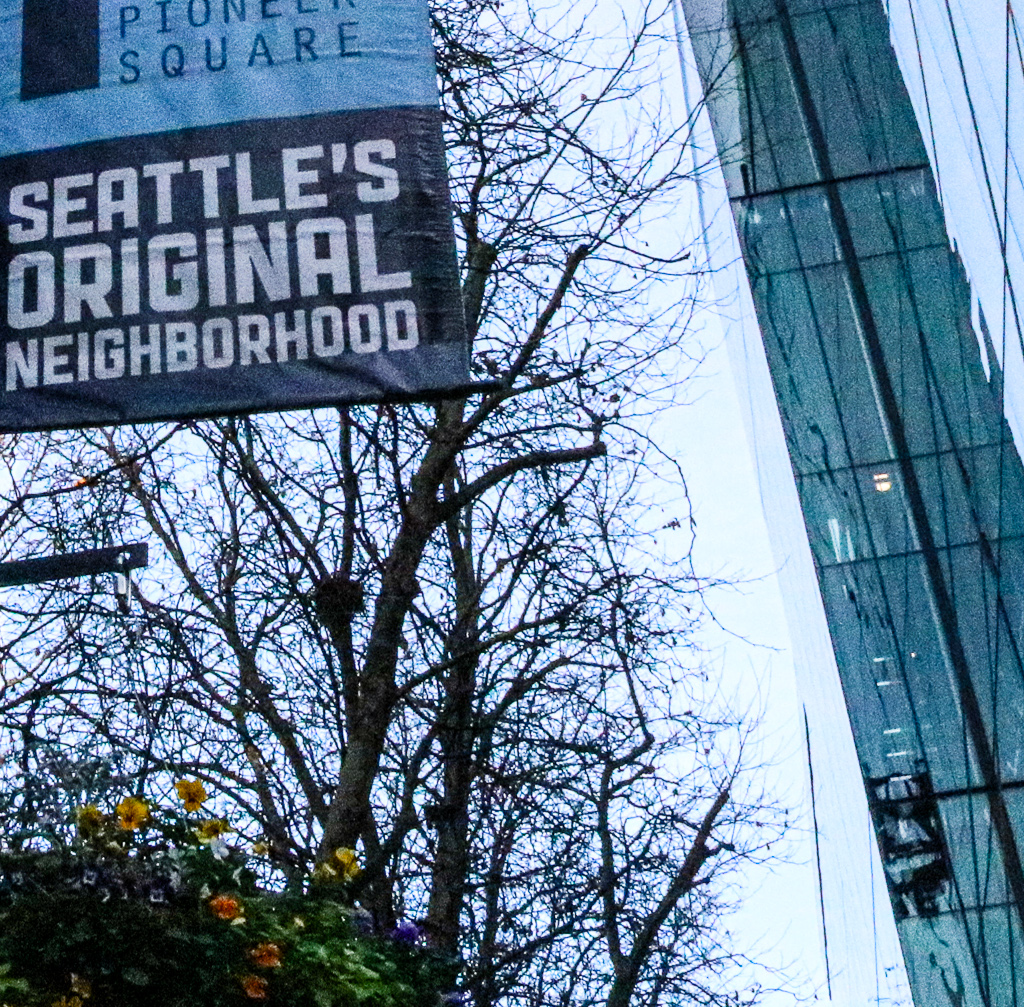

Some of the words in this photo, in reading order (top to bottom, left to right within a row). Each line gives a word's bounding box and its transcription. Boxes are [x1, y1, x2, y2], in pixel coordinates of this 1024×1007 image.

[119, 21, 362, 84] SQUARE
[9, 139, 399, 243] SEATTLE'S
[7, 213, 412, 330] ORIGINAL
[5, 299, 419, 391] NEIGHBORHOOD
